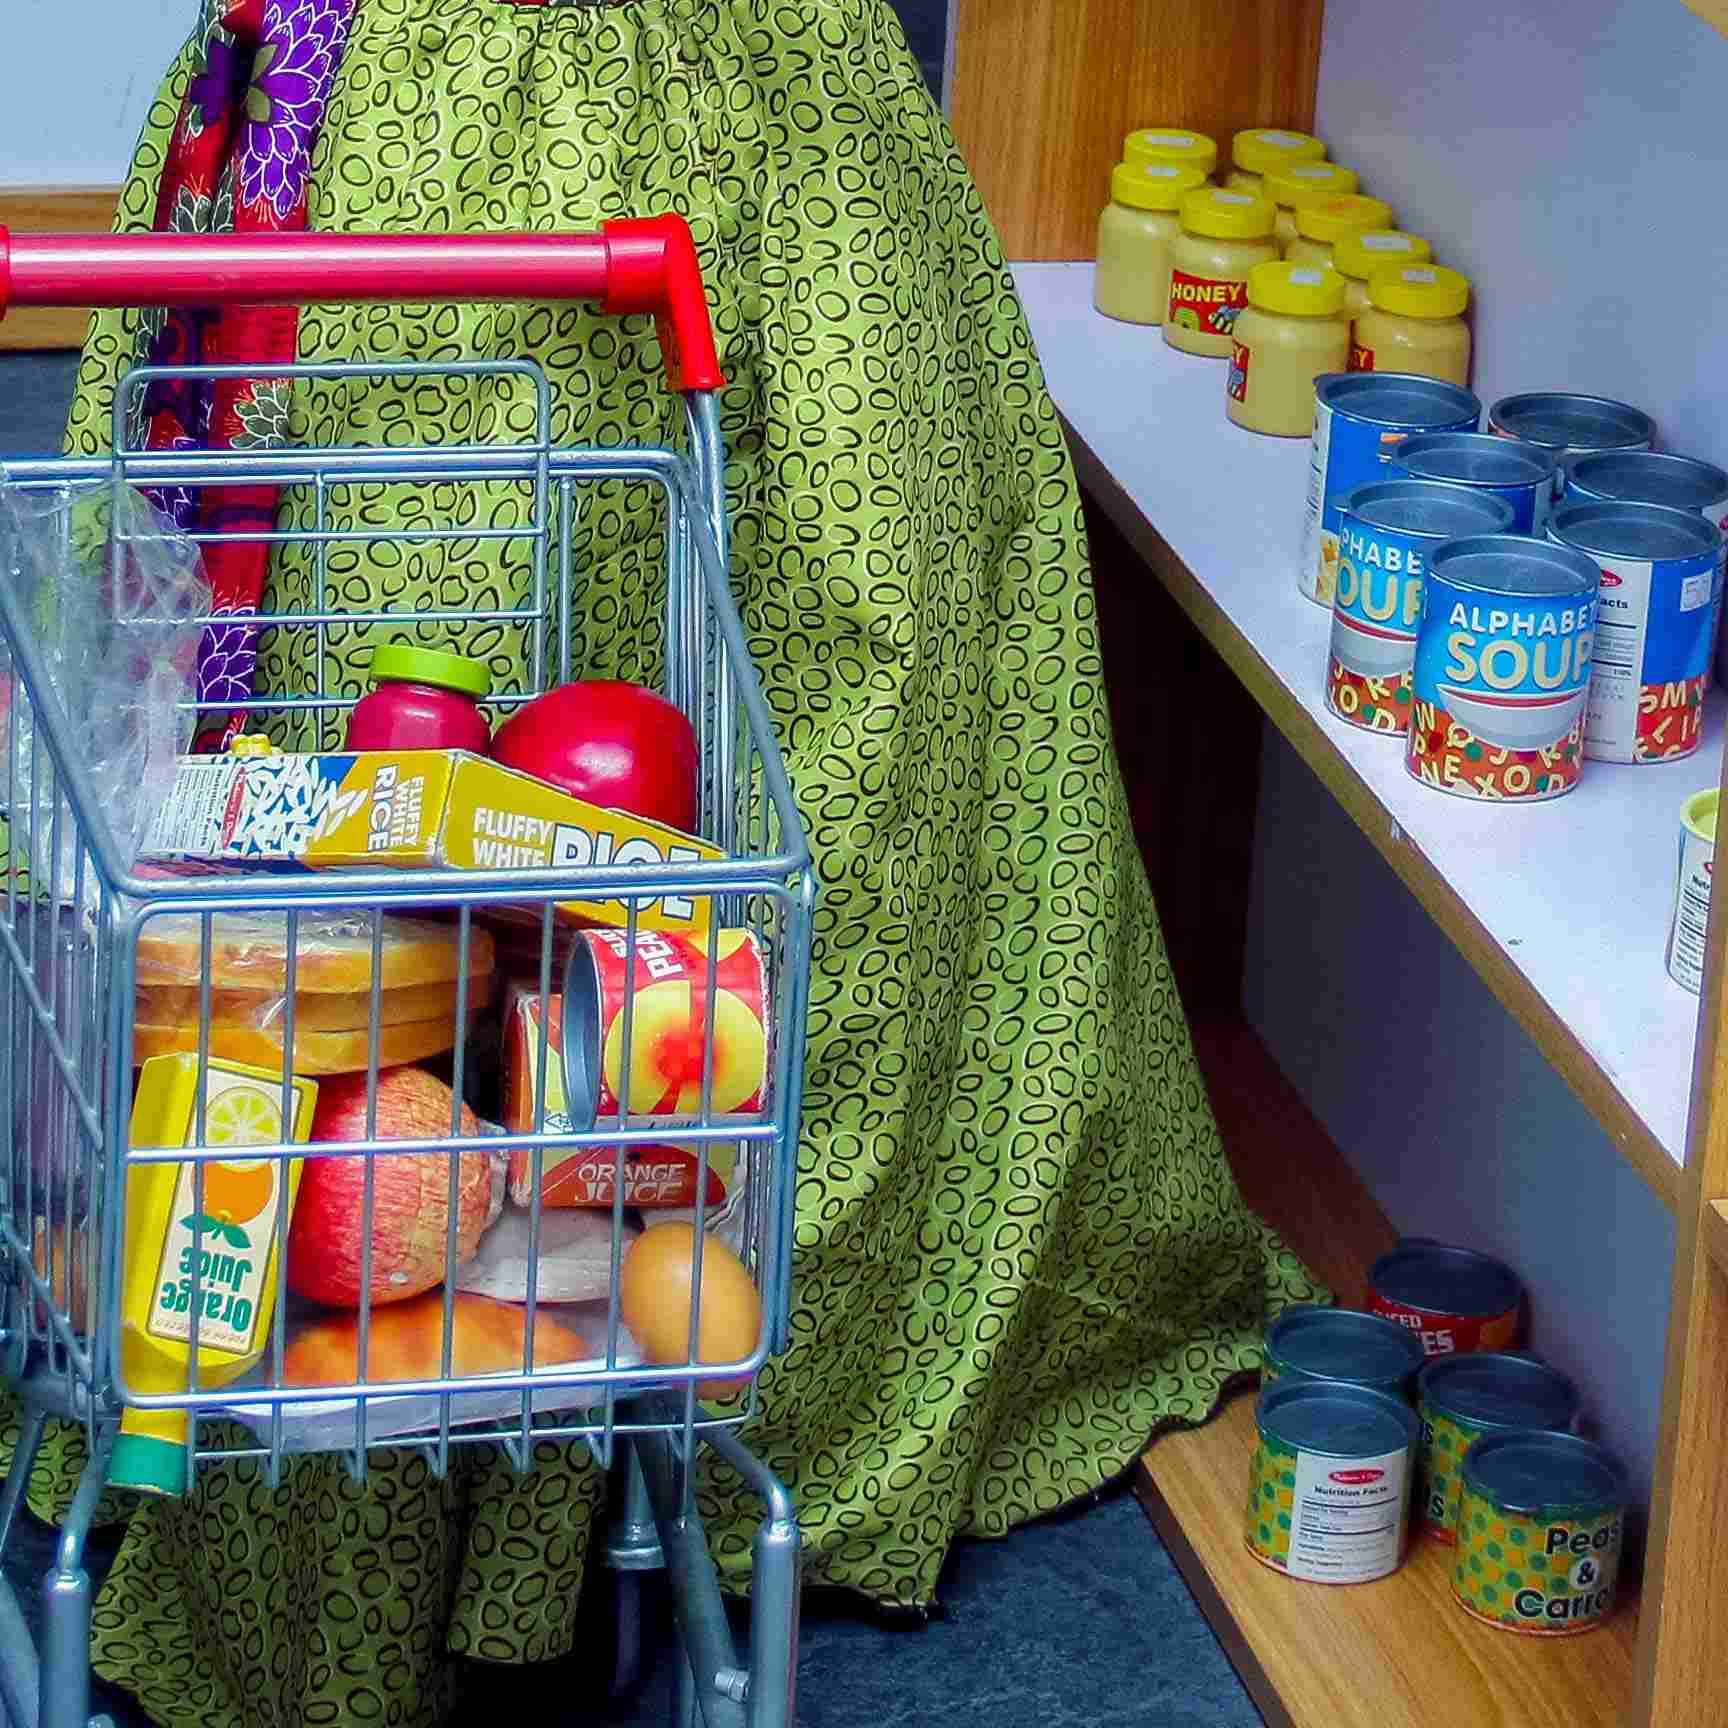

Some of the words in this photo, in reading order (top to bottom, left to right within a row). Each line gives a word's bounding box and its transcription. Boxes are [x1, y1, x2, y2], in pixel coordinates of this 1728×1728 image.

[1171, 282, 1242, 303] HONEY
[1599, 598, 1629, 610] acts
[367, 763, 401, 852] RICE
[389, 778, 410, 847] WHITE
[404, 775, 425, 847] FLUFFY
[473, 806, 555, 845] FLUFFY
[472, 837, 546, 869] WHITE
[578, 1161, 688, 1184] ORANGE
